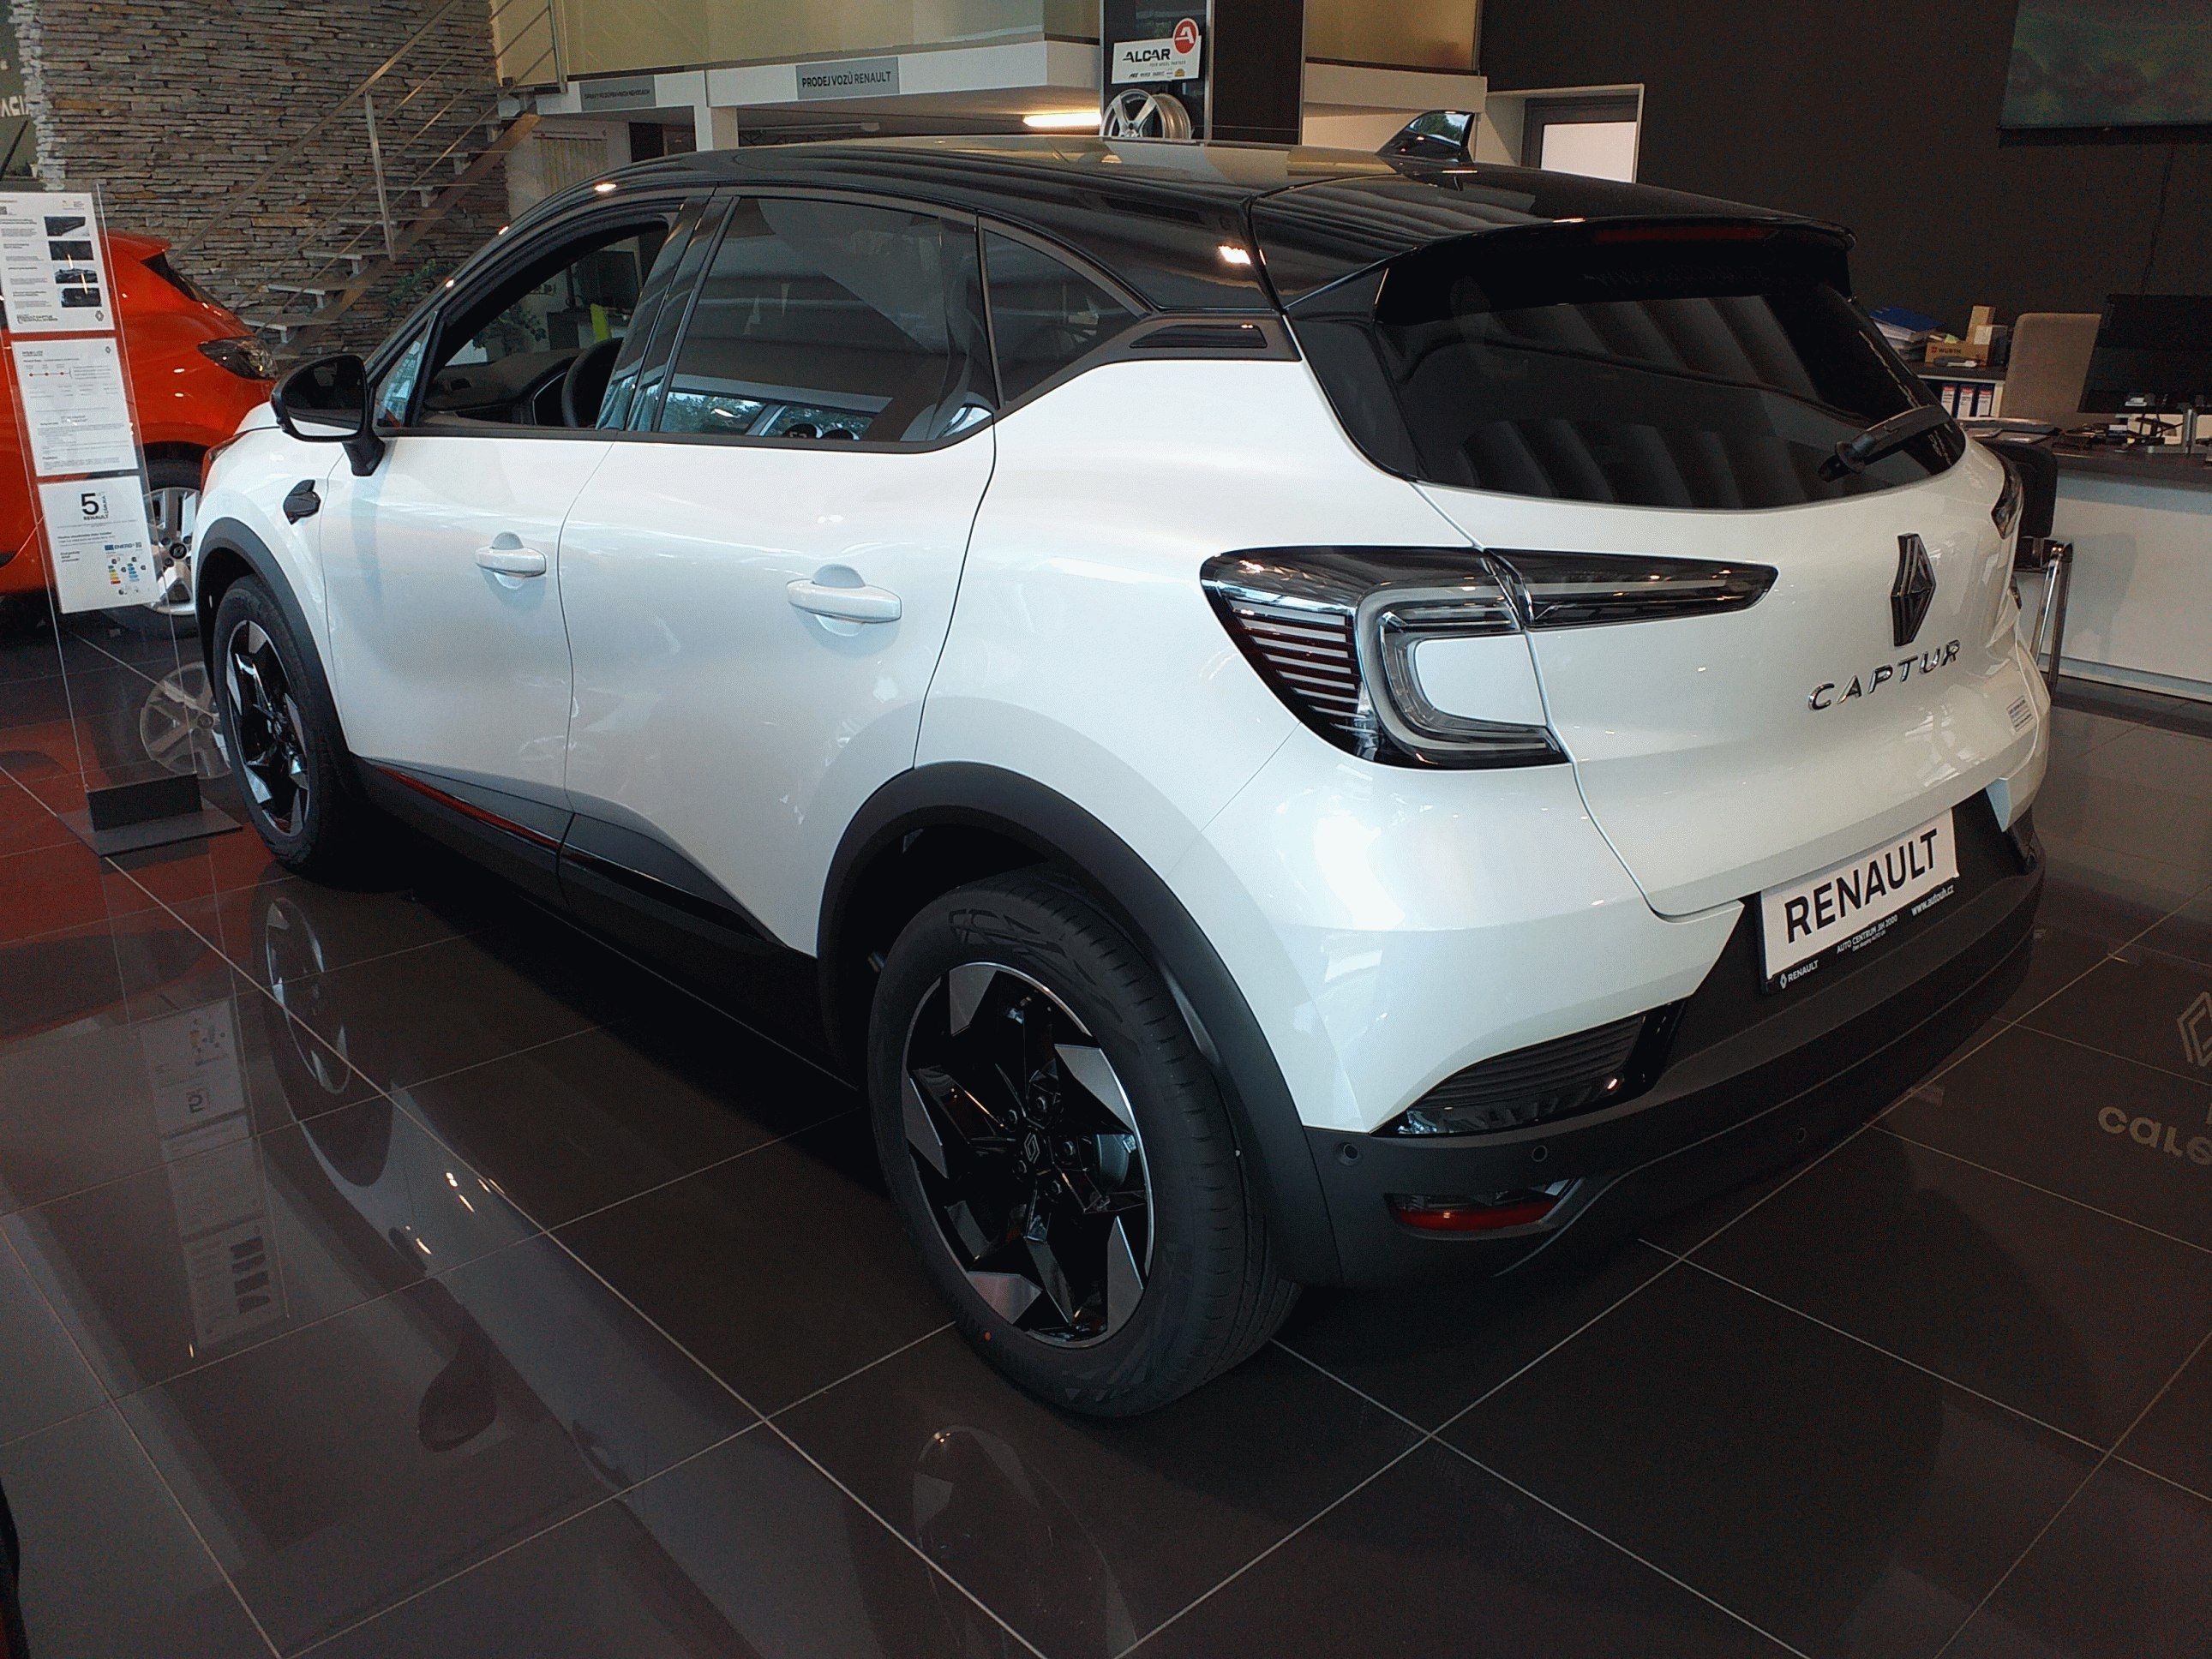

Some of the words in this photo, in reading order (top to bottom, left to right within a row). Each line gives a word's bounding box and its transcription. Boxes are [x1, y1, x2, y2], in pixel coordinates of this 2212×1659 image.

[1122, 48, 1171, 63] ALCAR
[802, 76, 830, 87] PRODEJ
[830, 71, 853, 86] VOZŮ
[854, 71, 891, 84] RENAULT
[1, 95, 29, 117] ACI
[81, 492, 99, 516] 5
[1807, 638, 1961, 711] CAPTUR
[1783, 828, 1938, 944] RENAULT
[1911, 884, 1955, 917] www.autouh.cz
[1837, 939, 1853, 954] AUTO
[1852, 925, 1877, 948] CENTRUM
[1885, 914, 1898, 930] 2000
[1788, 960, 1819, 983] RENAULT
